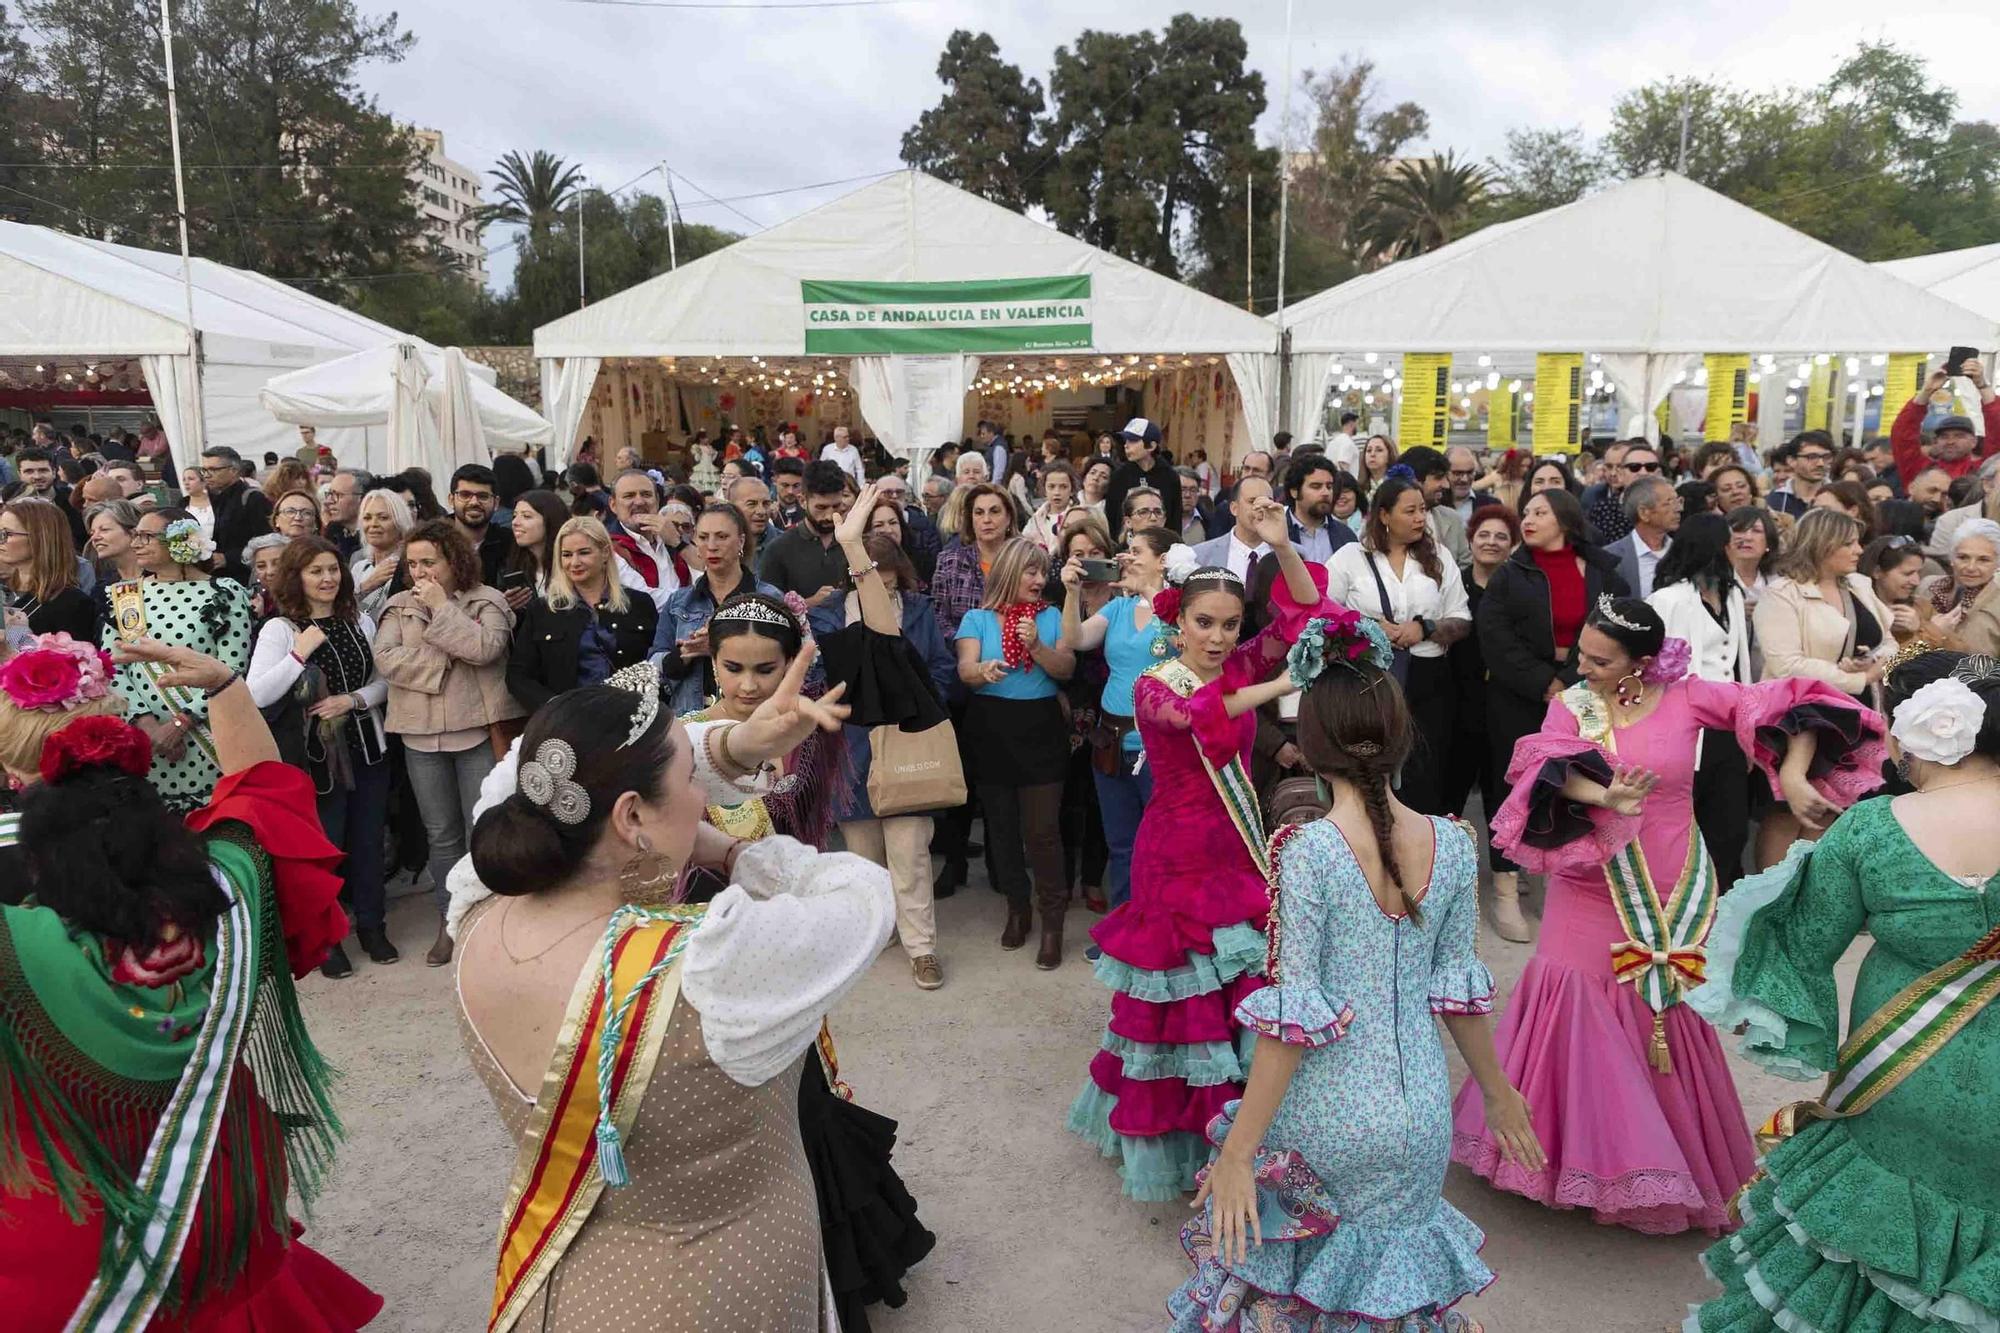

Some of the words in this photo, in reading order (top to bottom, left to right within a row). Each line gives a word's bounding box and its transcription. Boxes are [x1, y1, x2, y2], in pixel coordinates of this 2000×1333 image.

[810, 309, 850, 322] CASA
[856, 311, 876, 321] DE
[882, 309, 975, 322] ANDALUCIA
[981, 308, 1000, 320] EN
[1006, 305, 1084, 320] VALENCIA
